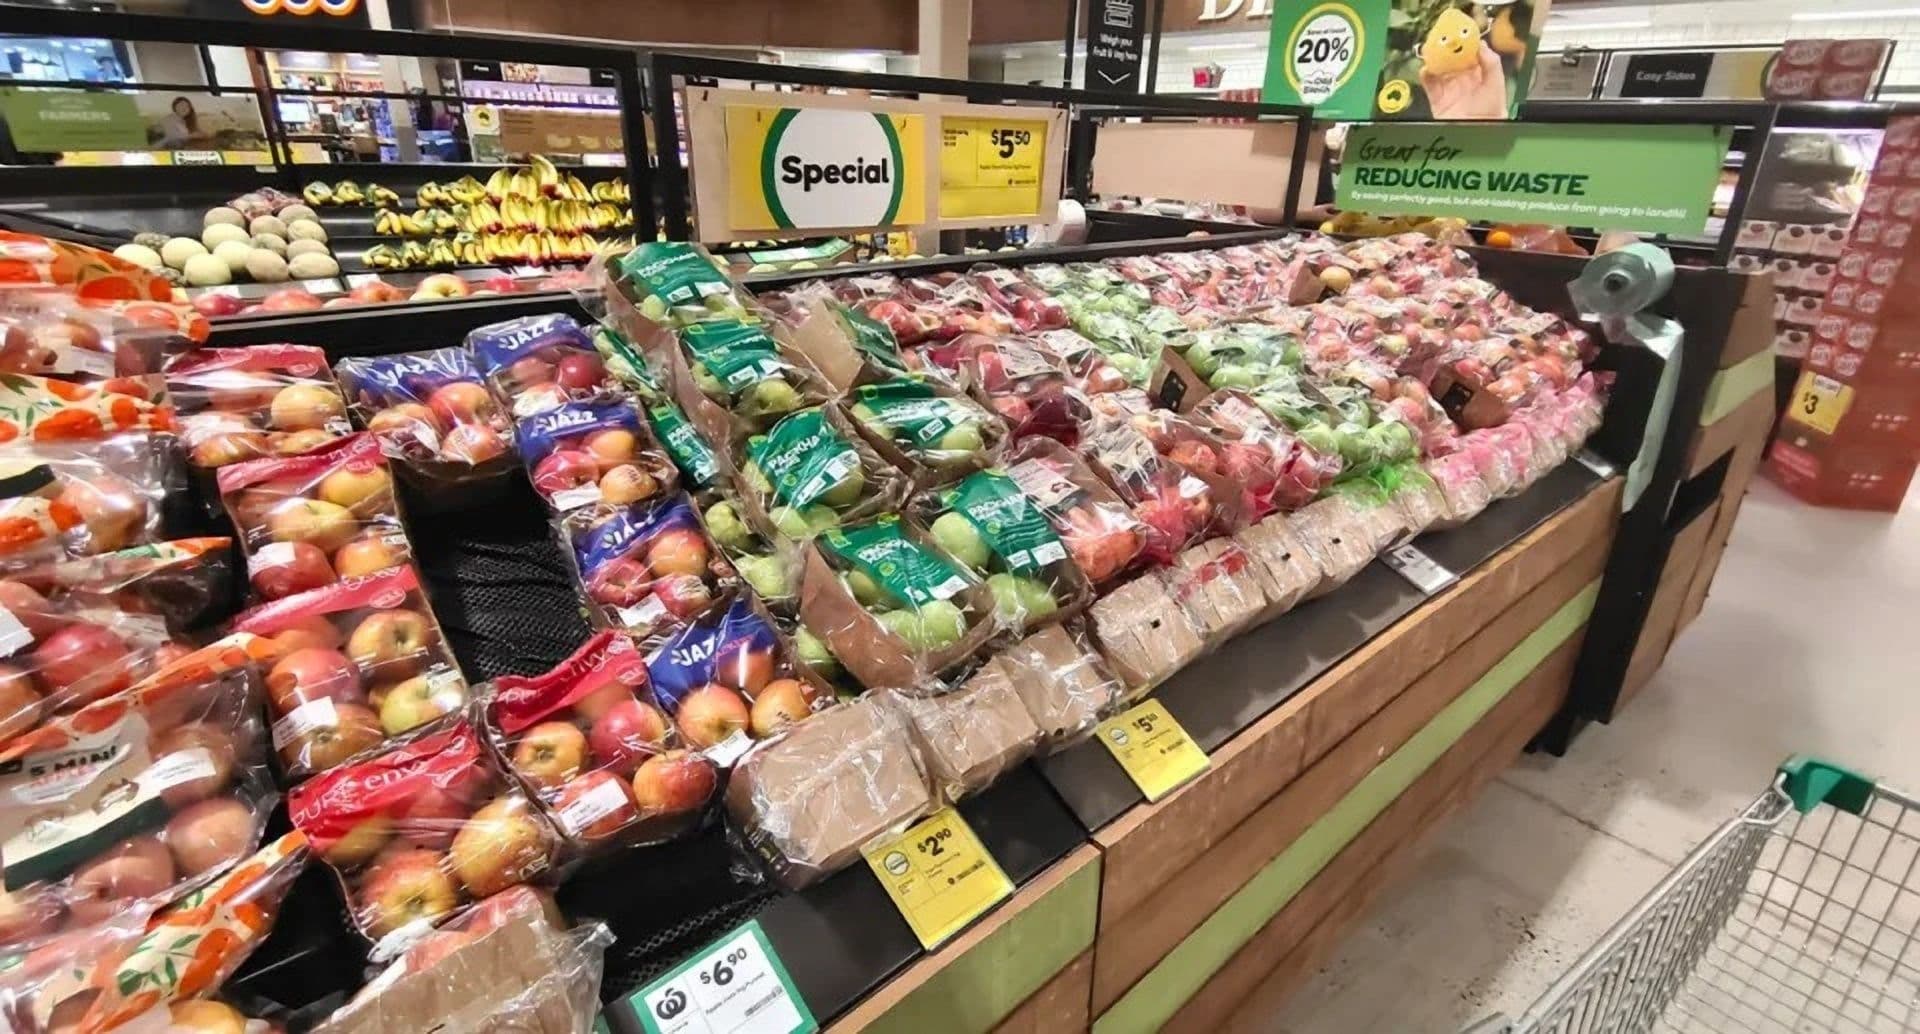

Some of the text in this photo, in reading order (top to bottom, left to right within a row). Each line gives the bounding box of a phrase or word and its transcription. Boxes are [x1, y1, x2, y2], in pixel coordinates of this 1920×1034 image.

[1297, 36, 1350, 63] 20%
[1636, 70, 1662, 83] Easy
[1359, 135, 1464, 170] Great for
[781, 155, 890, 192] Special
[1355, 167, 1590, 195] REDUCING WASTE
[1571, 202, 1597, 213] from
[1599, 205, 1631, 217] going
[1632, 207, 1644, 216] to
[508, 321, 554, 350] JAZZ
[545, 410, 597, 431] JAZZ
[680, 632, 719, 667] JAZ
